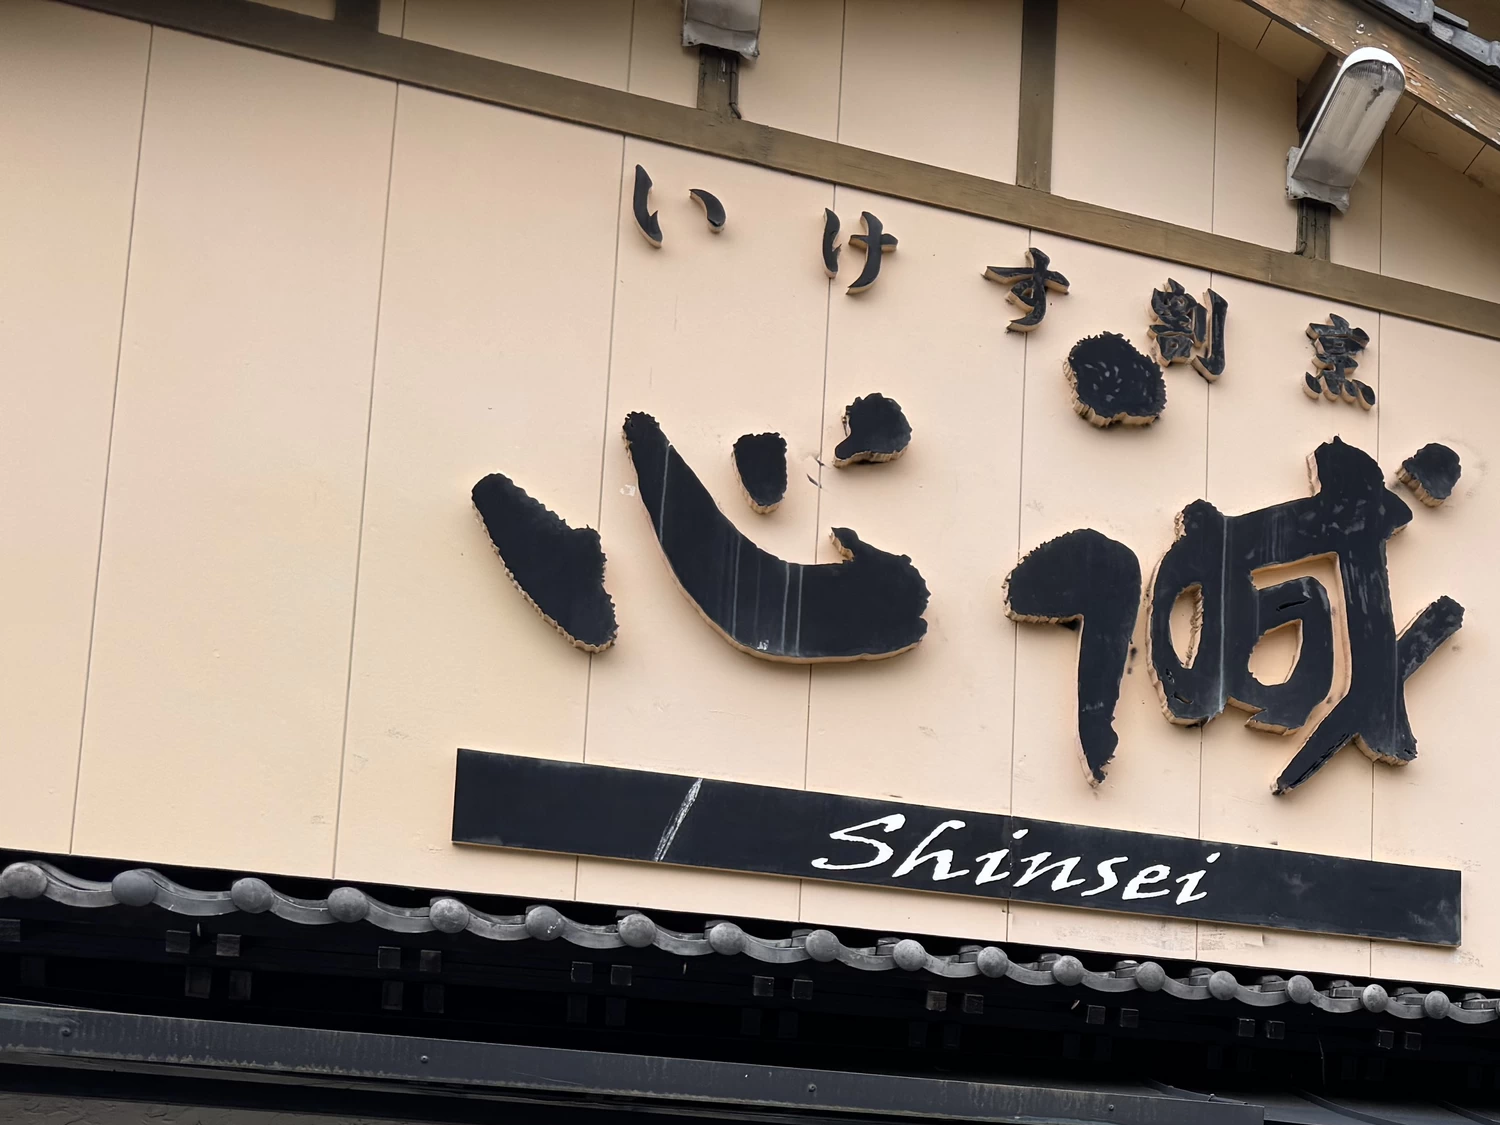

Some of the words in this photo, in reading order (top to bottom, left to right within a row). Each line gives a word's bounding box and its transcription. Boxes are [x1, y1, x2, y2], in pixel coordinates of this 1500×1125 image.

[633, 163, 1375, 409] いけす割烹
[471, 331, 1466, 797] 心誠
[811, 813, 1221, 906] Shinsei
